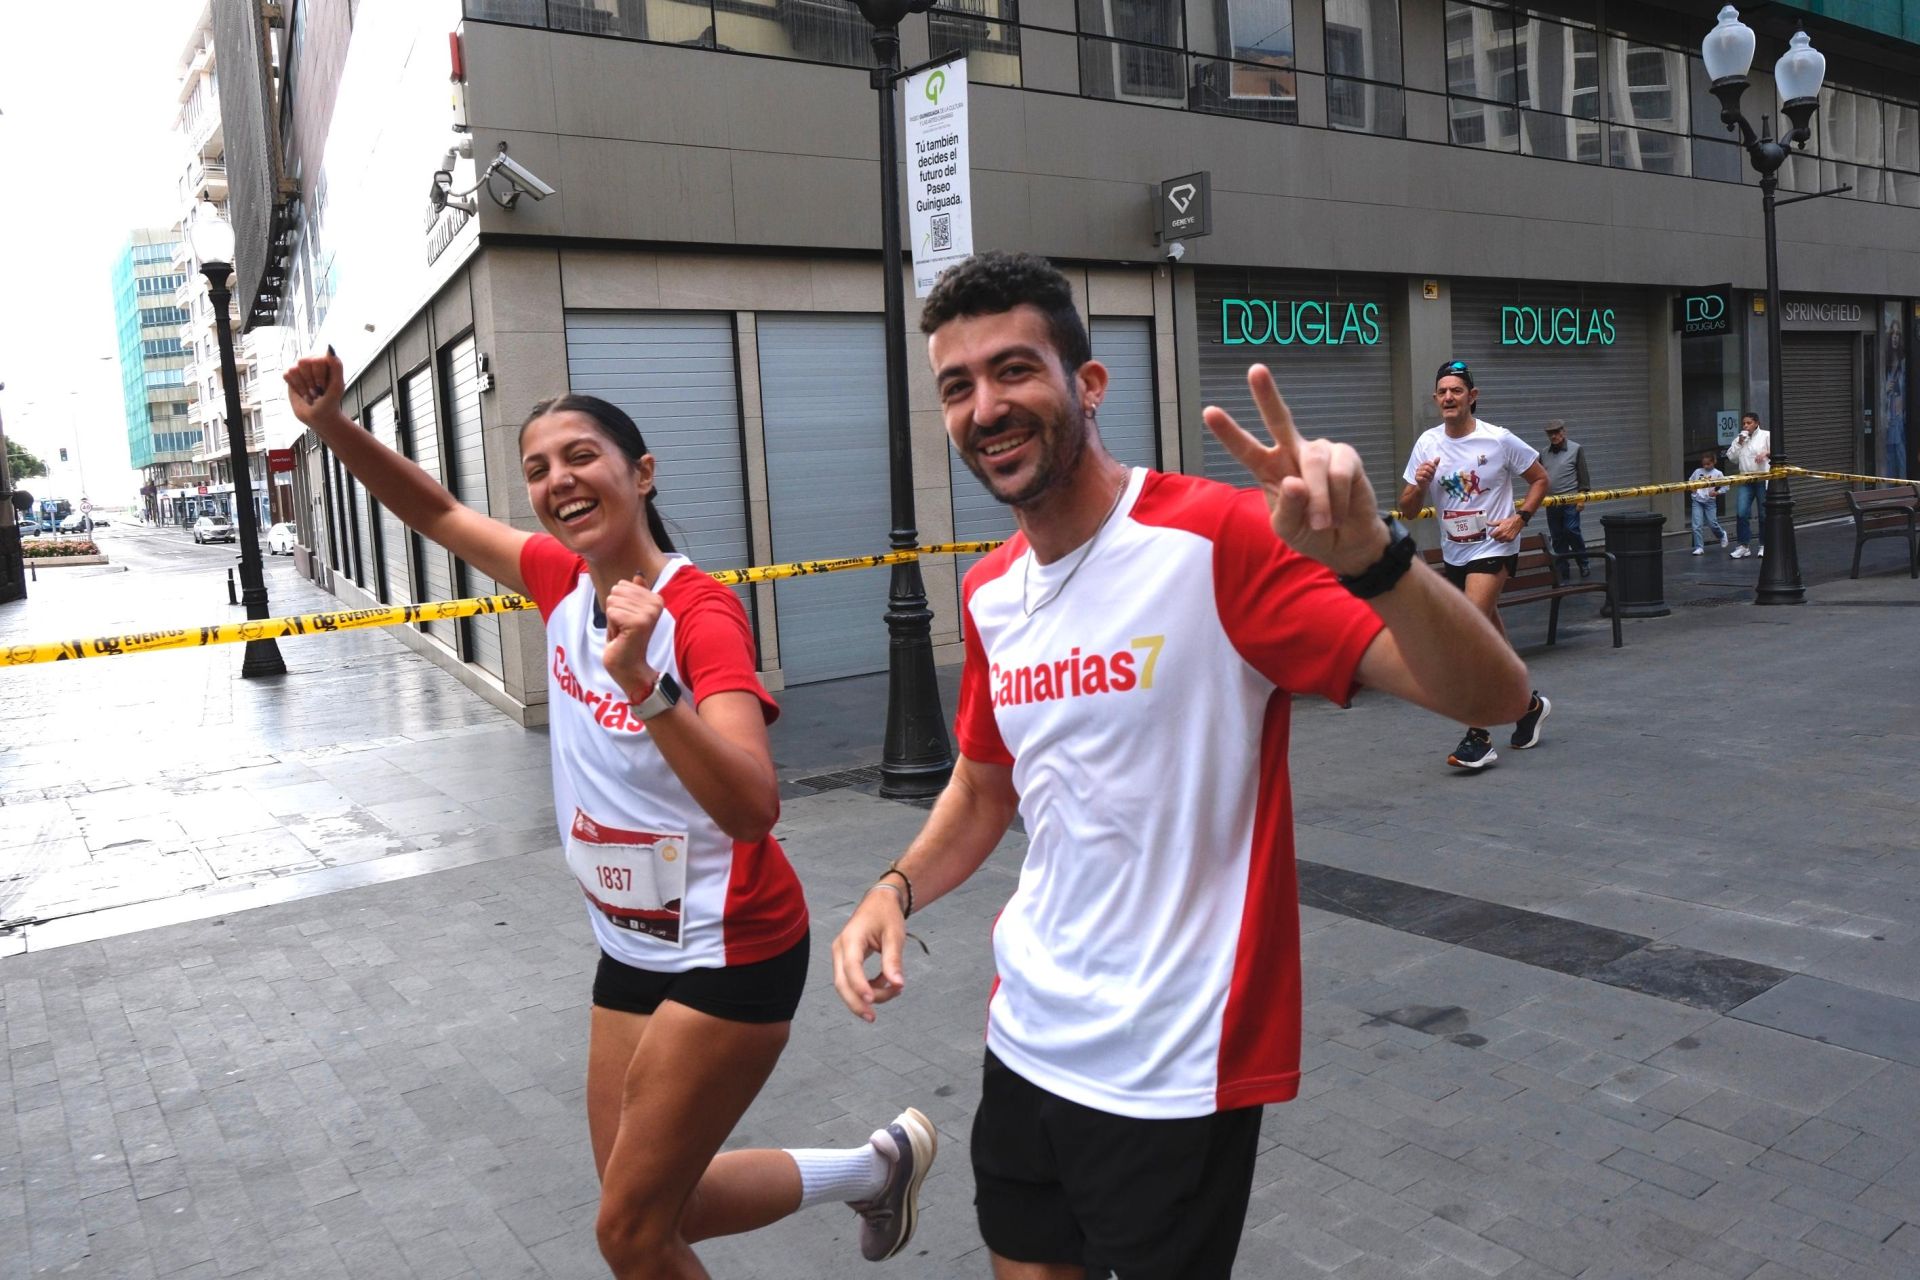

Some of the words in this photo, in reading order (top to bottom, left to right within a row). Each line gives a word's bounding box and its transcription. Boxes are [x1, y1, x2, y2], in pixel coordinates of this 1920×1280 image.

[915, 140, 926, 154] Tú
[926, 132, 959, 151] también
[918, 151, 949, 168] decides
[949, 147, 958, 160] el
[919, 168, 943, 182] futuro
[944, 162, 957, 177] del
[926, 182, 951, 195] Paseo
[916, 193, 963, 212] Guiniguada.
[1222, 299, 1380, 345] DOUGLAS
[1785, 302, 1862, 322] SPRINGFIELD
[1502, 306, 1615, 345] DOUGLAS
[1685, 320, 1726, 332] DOUGLAS
[339, 608, 391, 623] EVENTOS
[596, 864, 631, 892] 1837
